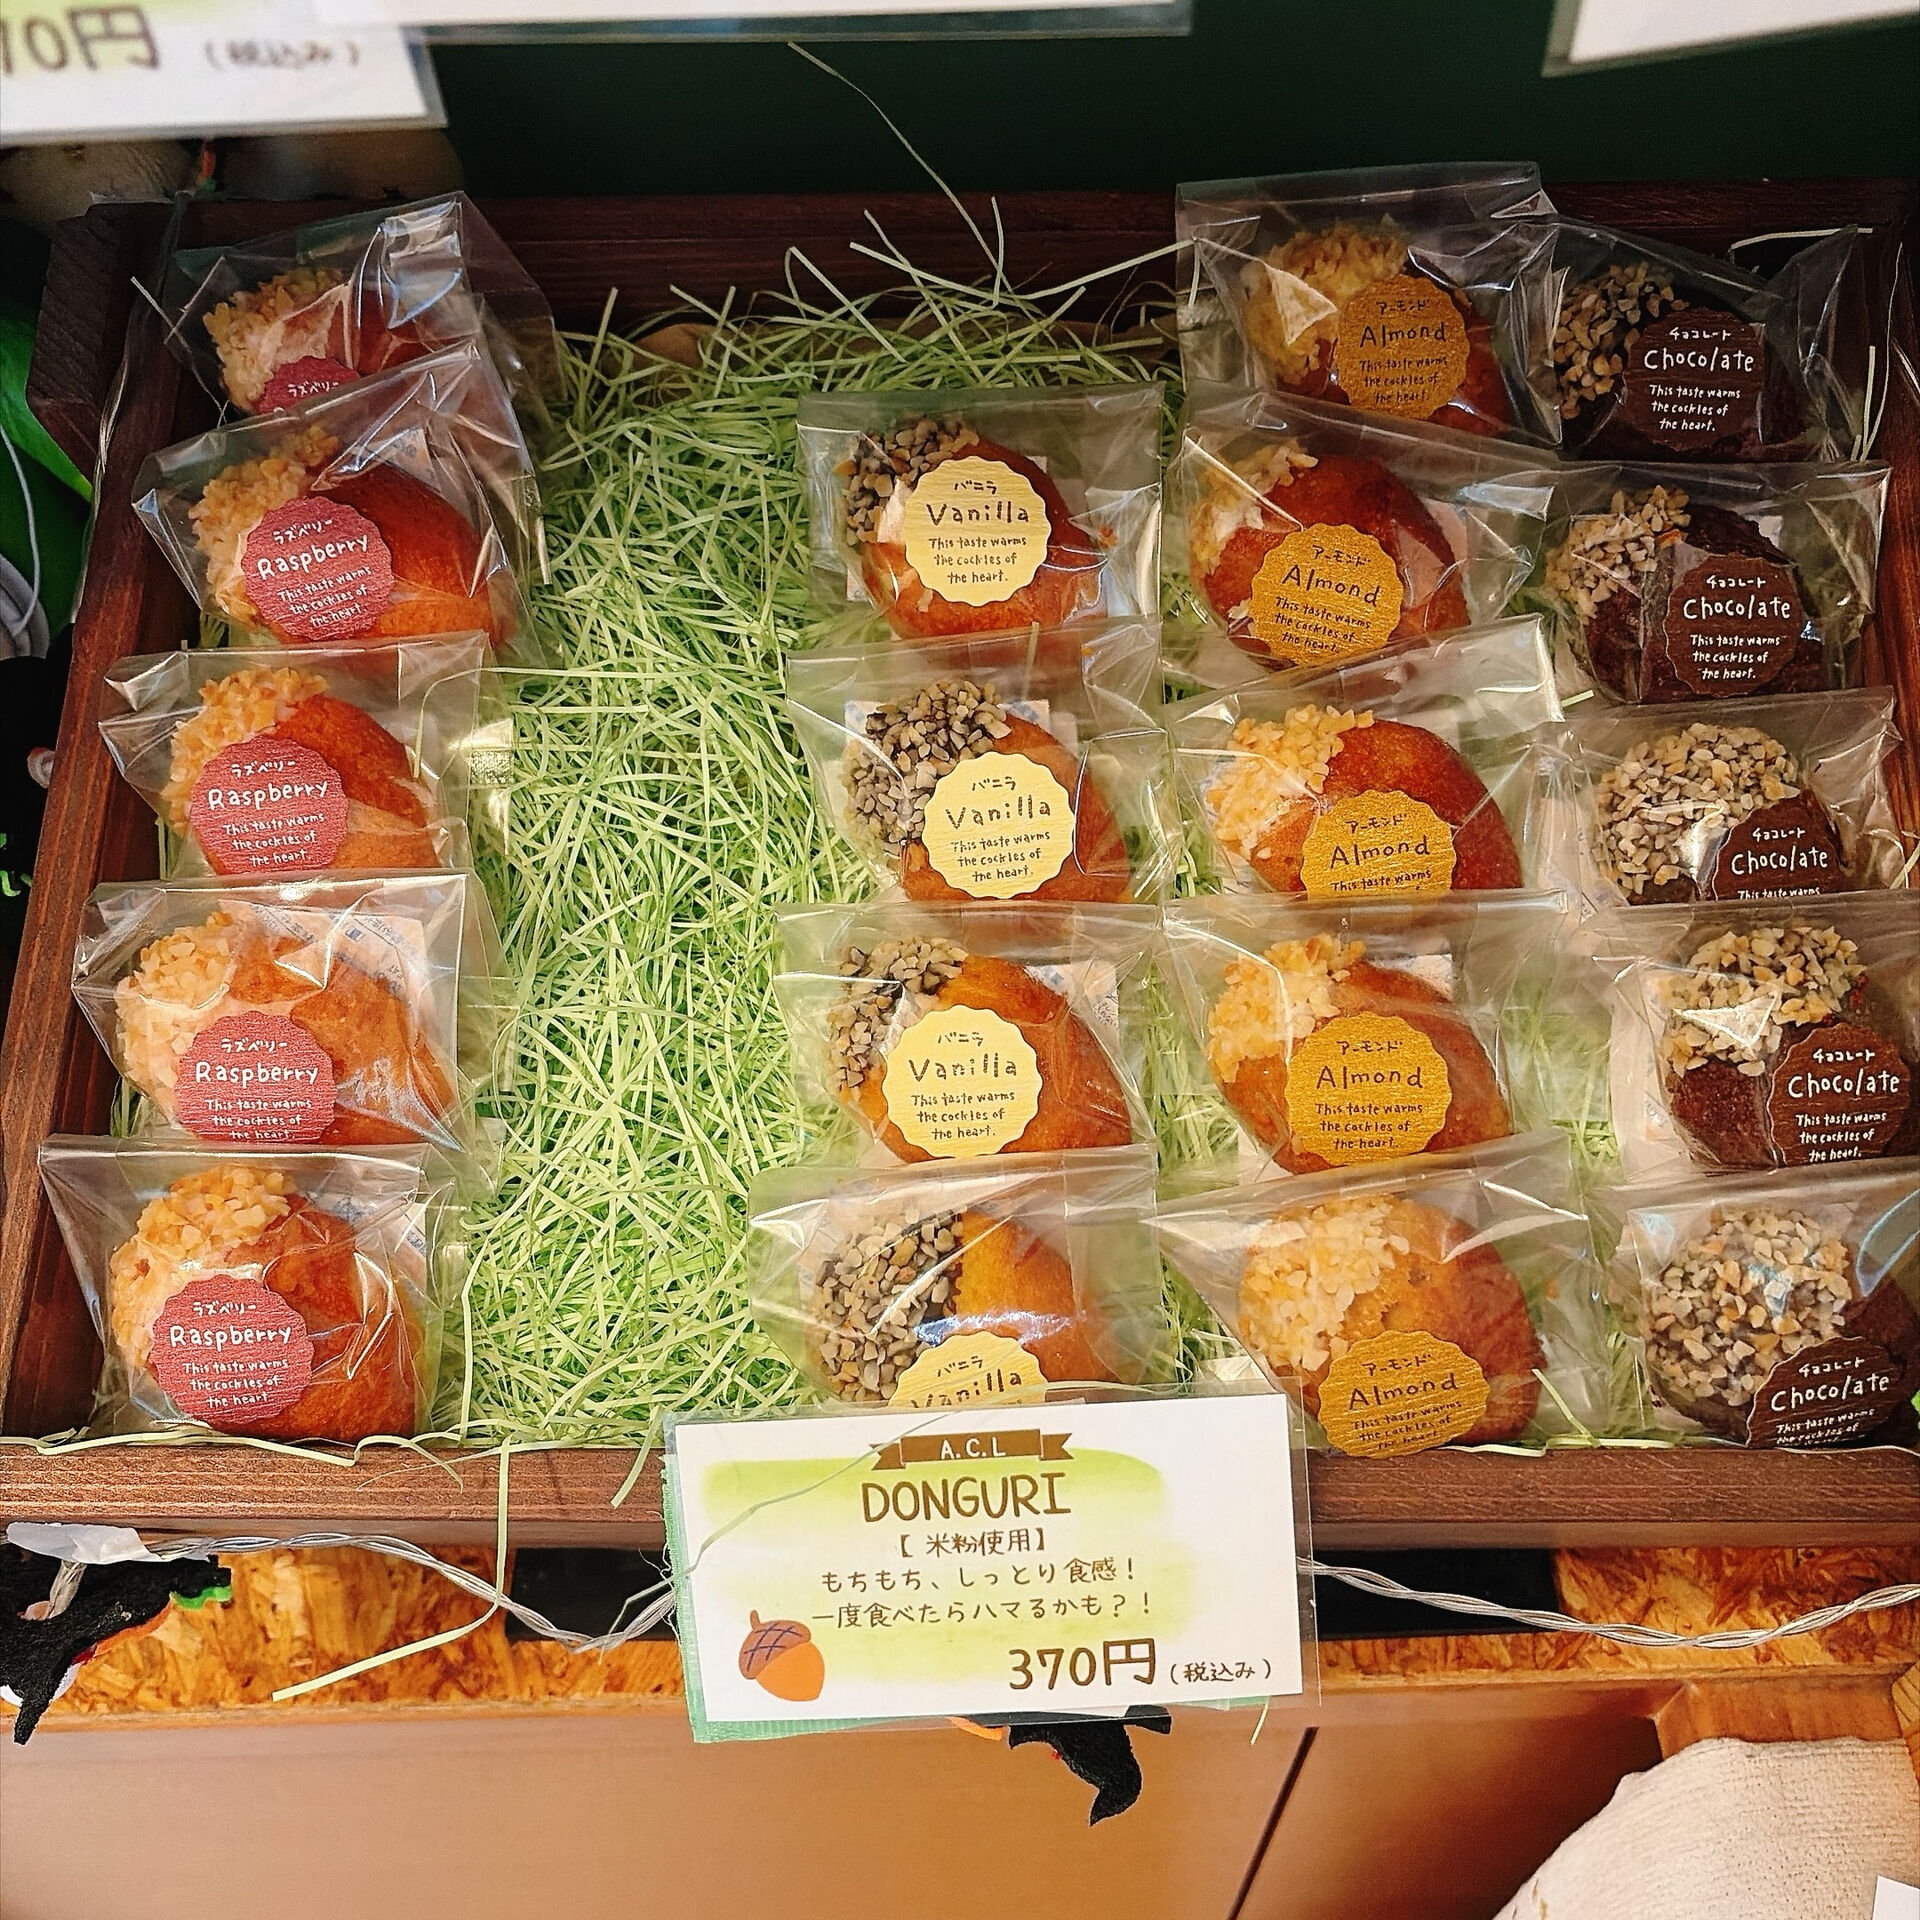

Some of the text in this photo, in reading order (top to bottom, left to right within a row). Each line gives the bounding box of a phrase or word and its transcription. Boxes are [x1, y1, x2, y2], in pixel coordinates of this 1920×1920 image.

[0, 2, 160, 76] 0円
[1376, 299, 1429, 315] アーモンド
[1360, 322, 1446, 348] Almond
[1669, 326, 1731, 341] チョコレート
[1360, 356, 1448, 372] This taste warms
[1644, 346, 1754, 372] Chocolate
[1364, 372, 1439, 387] the cockles of
[288, 381, 339, 397] ラズベリー
[1649, 384, 1740, 398] This taste warms
[1652, 400, 1728, 416] the cockles of
[1660, 418, 1676, 430] the
[954, 480, 997, 494] バニラ
[926, 501, 1029, 526] Vanilla
[273, 519, 333, 544] ラズベリー
[928, 536, 1026, 550] This taste warms
[257, 534, 368, 580] Raspberry
[934, 552, 1017, 565] the cockles of
[1312, 545, 1371, 566] アーモンド
[277, 566, 372, 602] This taste warms
[948, 572, 966, 584] the
[1282, 564, 1380, 607] Almond
[1706, 574, 1766, 589] チョコレート
[290, 584, 368, 615] the cockles of
[1683, 594, 1791, 620] Chocolate
[1276, 596, 1371, 628] This taste warms
[1275, 613, 1355, 643] the cockles of
[1282, 632, 1300, 644] the
[1690, 634, 1780, 646] This taste warms
[1692, 650, 1768, 663] the cockles of
[1701, 668, 1719, 680] the
[231, 760, 296, 778] ラズベリー
[972, 776, 1016, 791] バニラ
[208, 781, 328, 811] Raspberry
[945, 795, 1051, 829] Vanilla
[222, 813, 325, 836] This taste warms
[1346, 814, 1407, 834] アーモンド
[232, 830, 317, 850] the cockles of
[951, 832, 1050, 853] This taste warms
[1752, 827, 1806, 842] チョコレート
[958, 848, 1042, 867] the cockles of
[1331, 835, 1430, 869] Almond
[1732, 845, 1828, 875] Chocolate
[250, 855, 269, 866] the
[972, 871, 992, 882] the
[1331, 870, 1431, 891] This taste warms
[221, 1037, 288, 1053] ラズベリー
[938, 1032, 983, 1046] バニラ
[1337, 1041, 1402, 1055] アーモンド
[1813, 1049, 1875, 1063] チョコレート
[196, 1061, 318, 1089] Raspberry
[909, 1053, 1017, 1082] Vanilla
[1317, 1066, 1423, 1089] Almond
[1788, 1068, 1899, 1098] Chocolate
[205, 1099, 312, 1111] This taste warms
[911, 1092, 1015, 1107] This taste warms
[917, 1108, 1005, 1123] the cockles of
[1315, 1103, 1422, 1115] This taste warms
[212, 1114, 302, 1126] the cockles of
[1320, 1120, 1410, 1132] the cockles of
[1795, 1112, 1887, 1127] This taste warms
[230, 1131, 251, 1139] the
[931, 1128, 952, 1140] the
[1799, 1128, 1875, 1144] the cockles of
[1333, 1138, 1354, 1150] the
[1809, 1149, 1826, 1162] the
[193, 1300, 257, 1316] ラズベリー
[170, 1324, 291, 1352] Raspberry
[183, 1359, 288, 1375] This taste warms
[937, 1356, 983, 1377] バニラ
[1362, 1354, 1432, 1376] アーモンド
[1799, 1357, 1865, 1377] チョコレート
[190, 1375, 283, 1391] the cockles of
[1349, 1373, 1459, 1410] Almond
[1771, 1373, 1889, 1411] Chocolate
[206, 1396, 228, 1408] the
[940, 1436, 1006, 1460] A.C.L
[861, 1472, 1071, 1523] DONGURI
[1008, 1638, 1156, 1690] 370円
